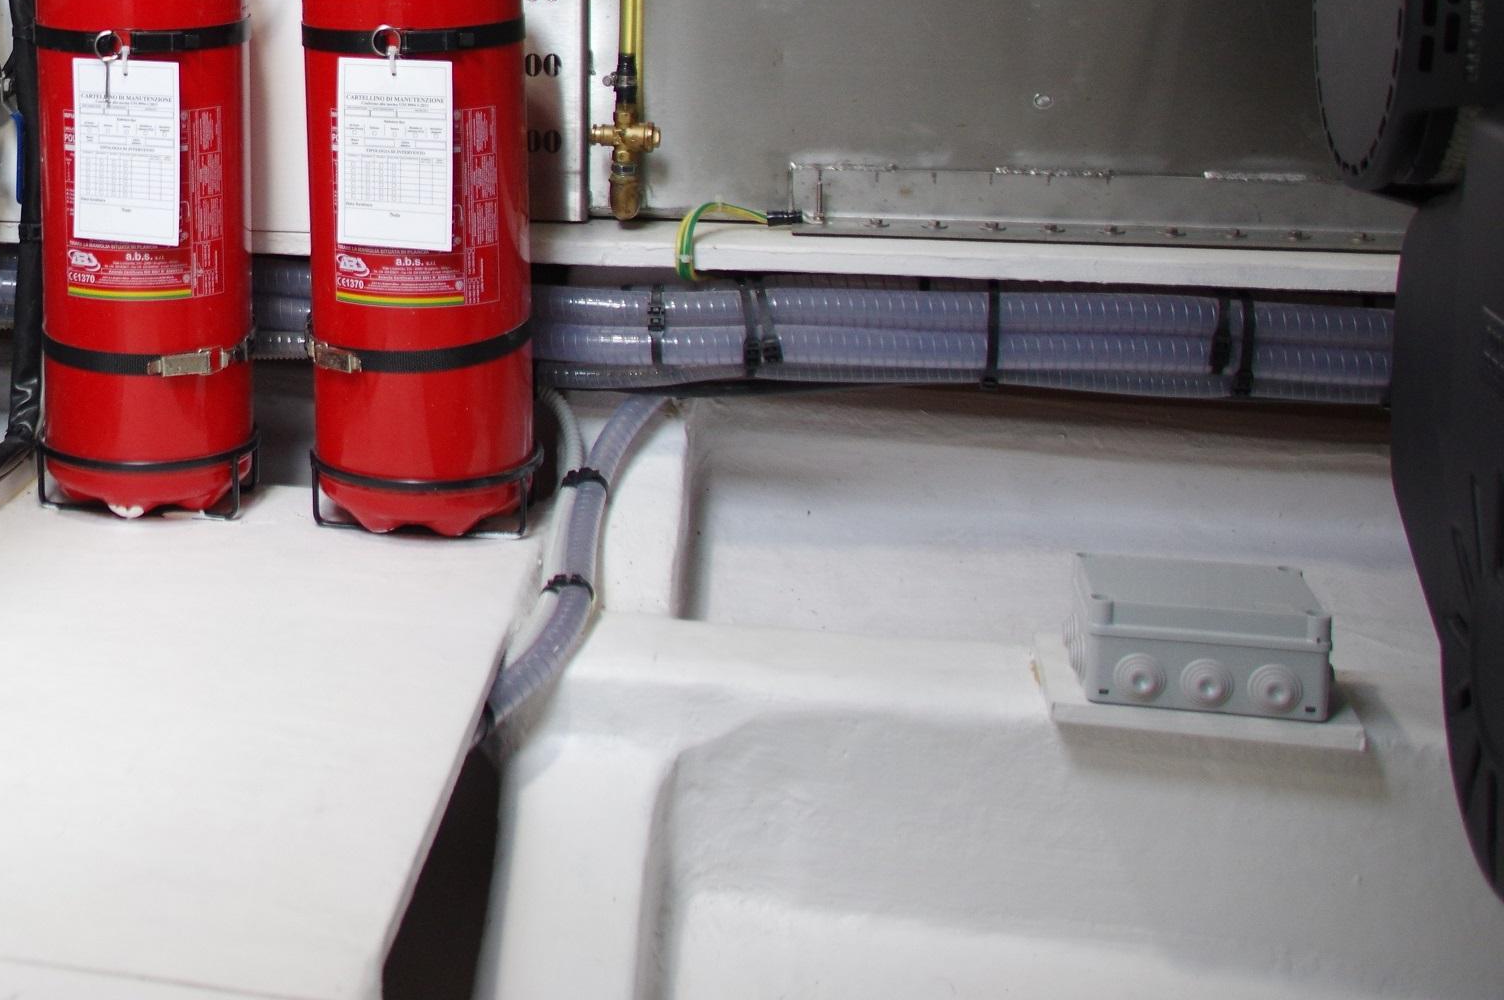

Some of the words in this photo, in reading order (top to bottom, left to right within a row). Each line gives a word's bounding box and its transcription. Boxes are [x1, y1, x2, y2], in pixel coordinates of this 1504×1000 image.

[525, 53, 563, 78] 00
[125, 251, 153, 261] a.b.s.
[395, 256, 424, 267] a.b.s.
